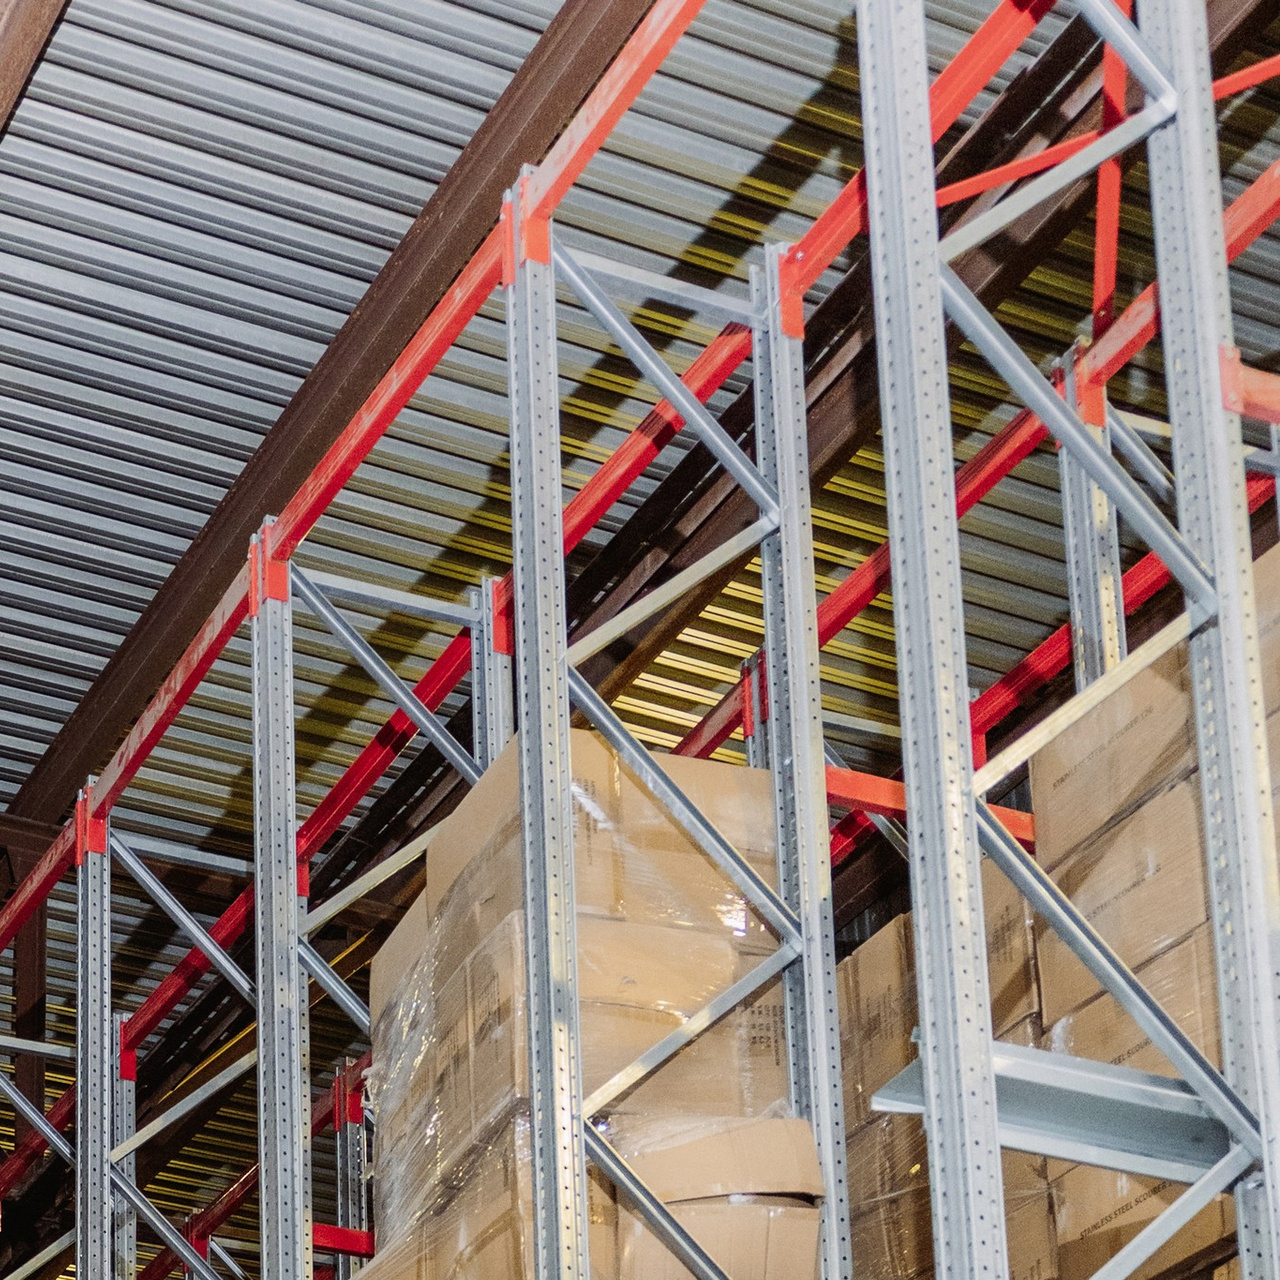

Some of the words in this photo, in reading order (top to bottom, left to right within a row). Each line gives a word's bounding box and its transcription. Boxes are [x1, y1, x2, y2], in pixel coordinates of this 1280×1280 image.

[1080, 1213, 1113, 1241] STAINLESS
[1114, 1201, 1133, 1218] STEEL
[1135, 1180, 1167, 1206] SCOURER
